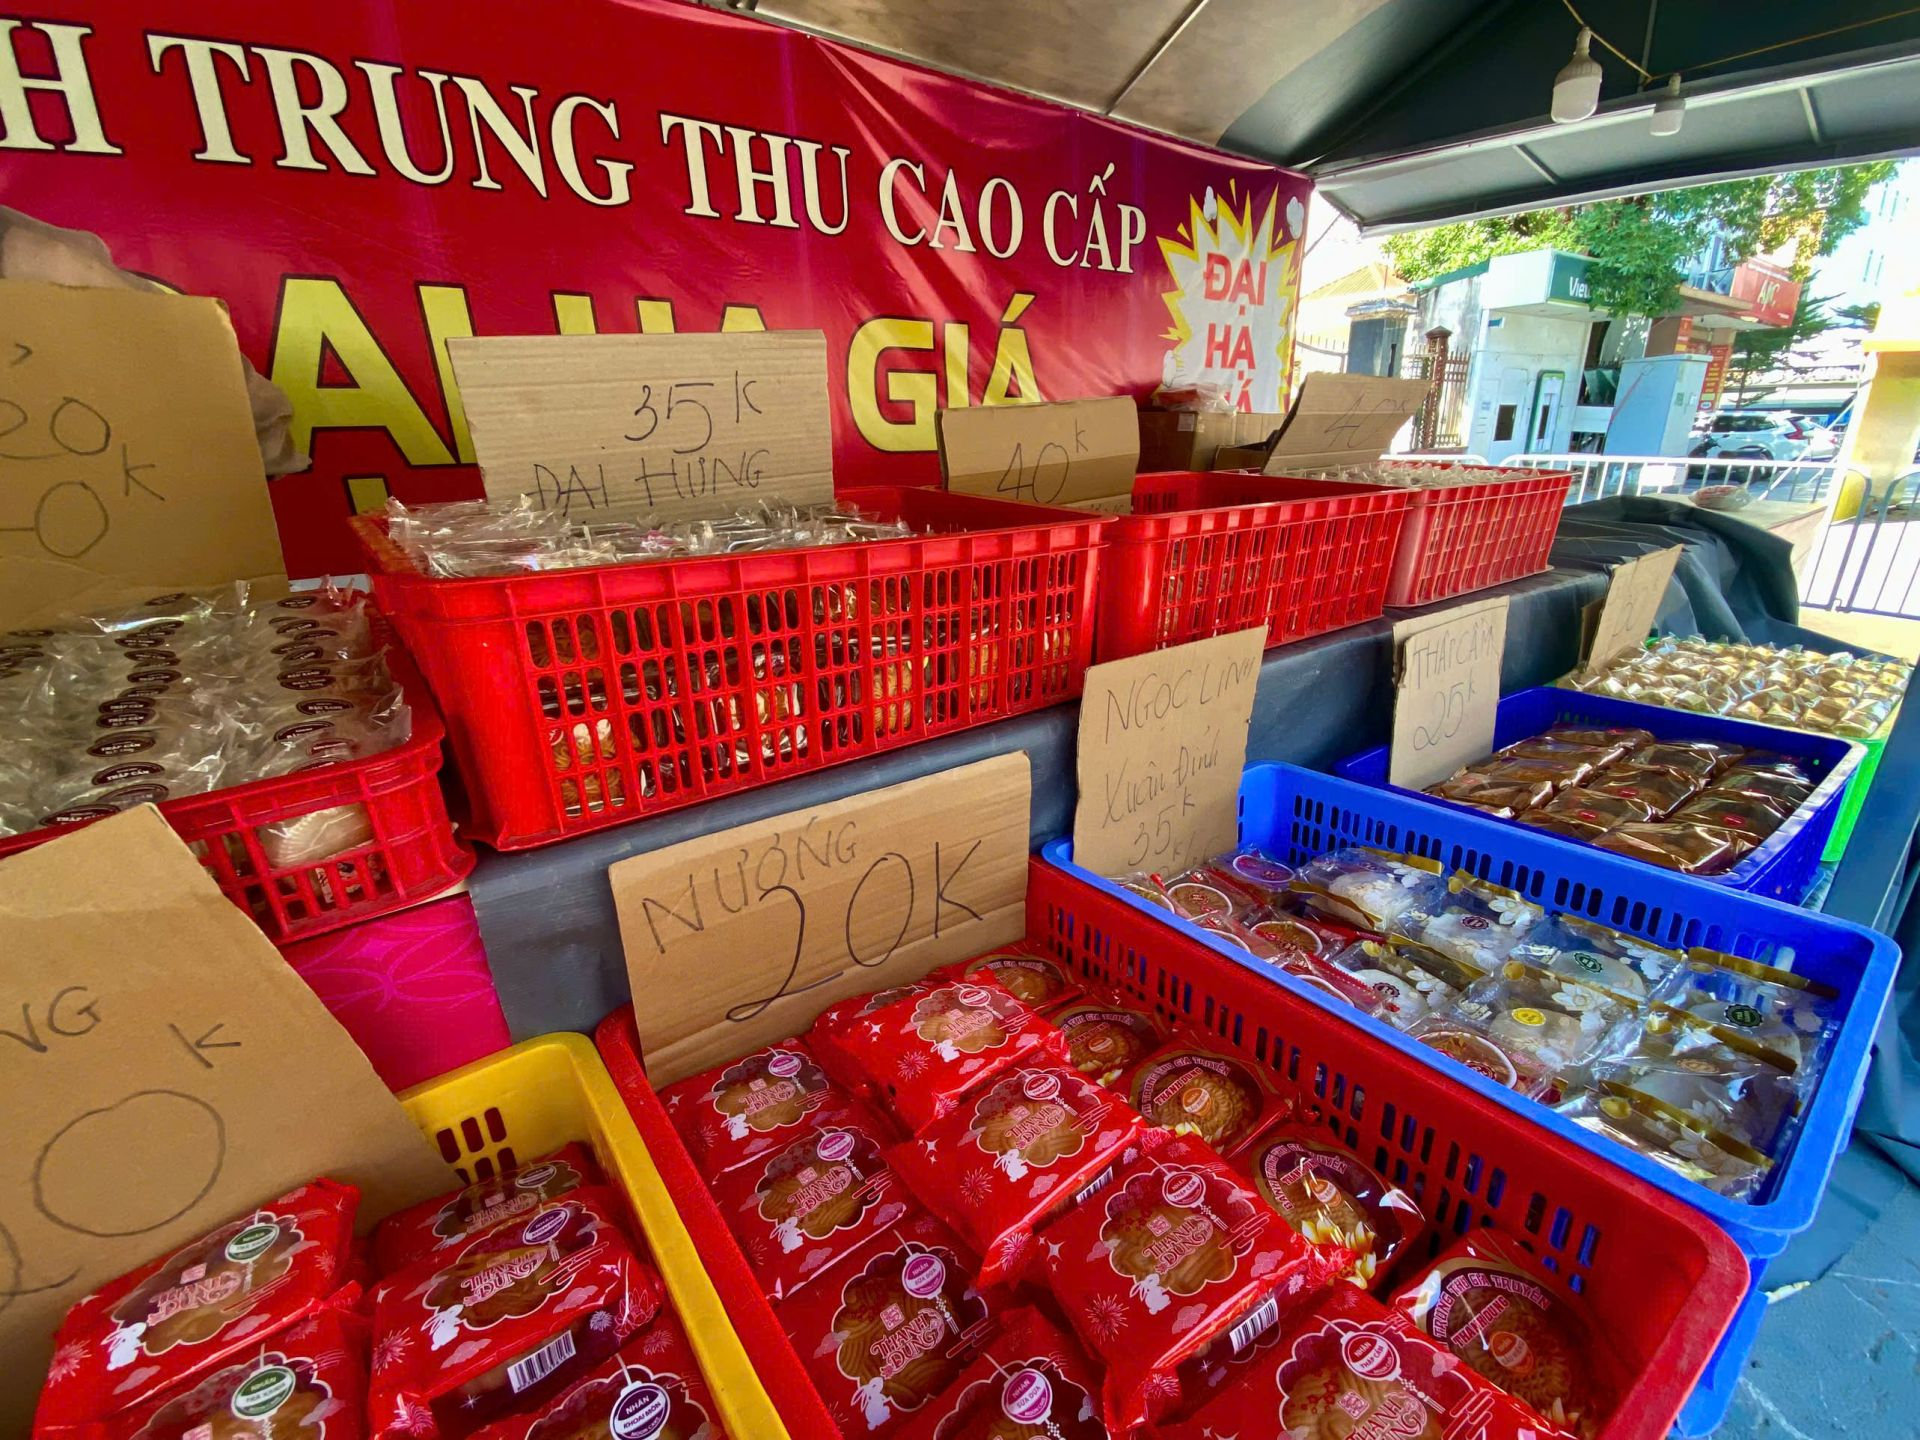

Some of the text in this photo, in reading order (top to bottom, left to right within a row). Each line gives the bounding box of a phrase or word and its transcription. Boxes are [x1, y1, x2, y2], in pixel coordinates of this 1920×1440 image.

[146, 33, 635, 207] TRUNG
[660, 111, 851, 236] THU
[878, 157, 1025, 259] CAO
[1041, 162, 1148, 275] CẤP
[1202, 252, 1267, 317] ĐẠI
[846, 290, 1040, 453] GIÁ
[1205, 322, 1257, 382] HẠ
[1142, 1219, 1195, 1259] THANH
[1160, 1229, 1207, 1266] DUNG
[870, 1312, 928, 1359] THANH
[1432, 1290, 1456, 1338] TRUNG
[887, 1327, 940, 1371] DUNG
